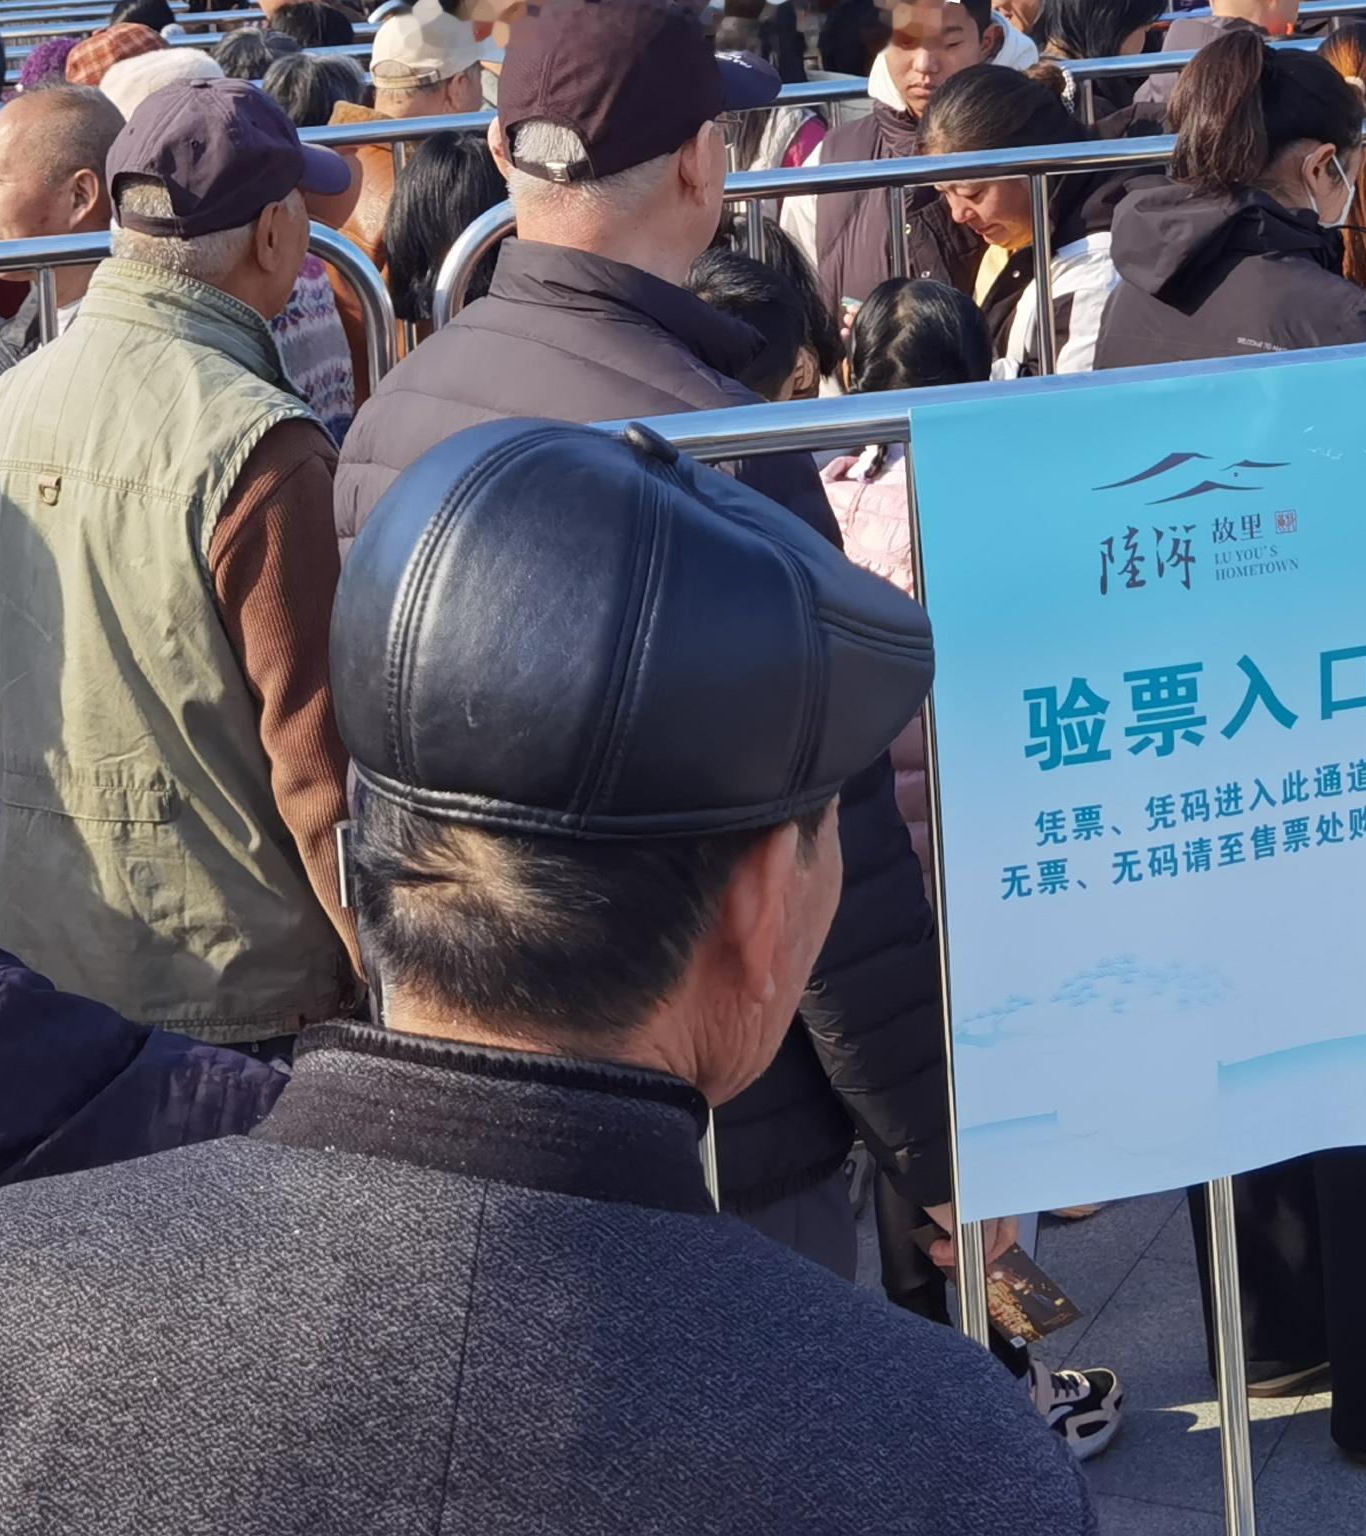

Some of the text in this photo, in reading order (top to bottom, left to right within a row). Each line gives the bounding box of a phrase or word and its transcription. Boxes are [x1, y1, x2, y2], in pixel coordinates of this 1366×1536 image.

[1212, 513, 1264, 544] 故里
[1215, 551, 1233, 565] LU
[1215, 558, 1300, 581] HOMETOWN
